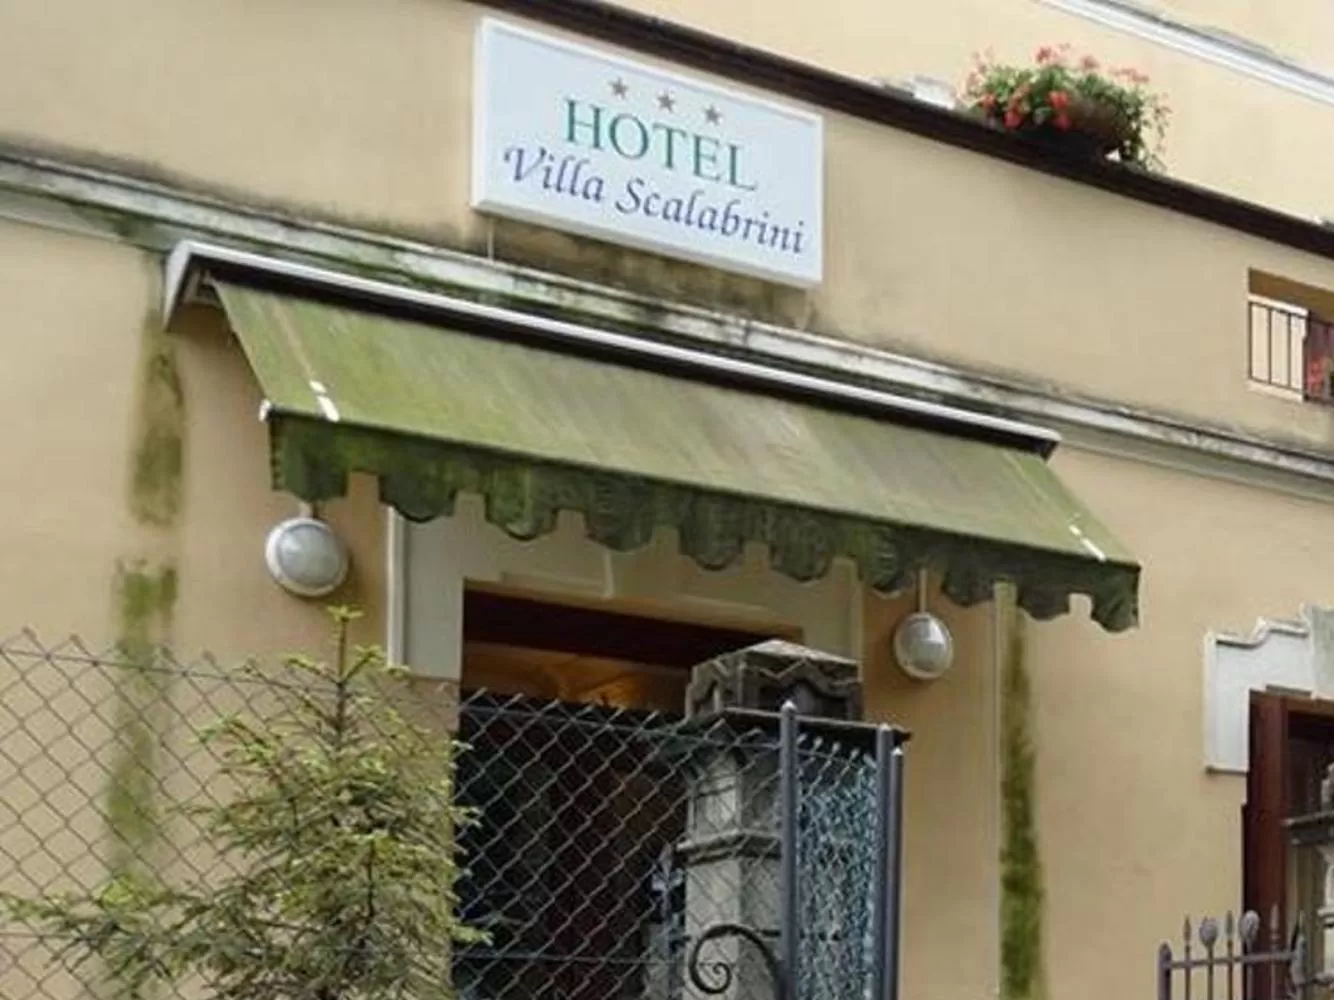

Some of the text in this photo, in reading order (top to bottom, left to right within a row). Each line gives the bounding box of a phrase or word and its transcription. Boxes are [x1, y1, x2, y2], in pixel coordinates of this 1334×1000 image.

[565, 98, 758, 191] HOTEL
[503, 145, 805, 254] Villa Scalabrini
